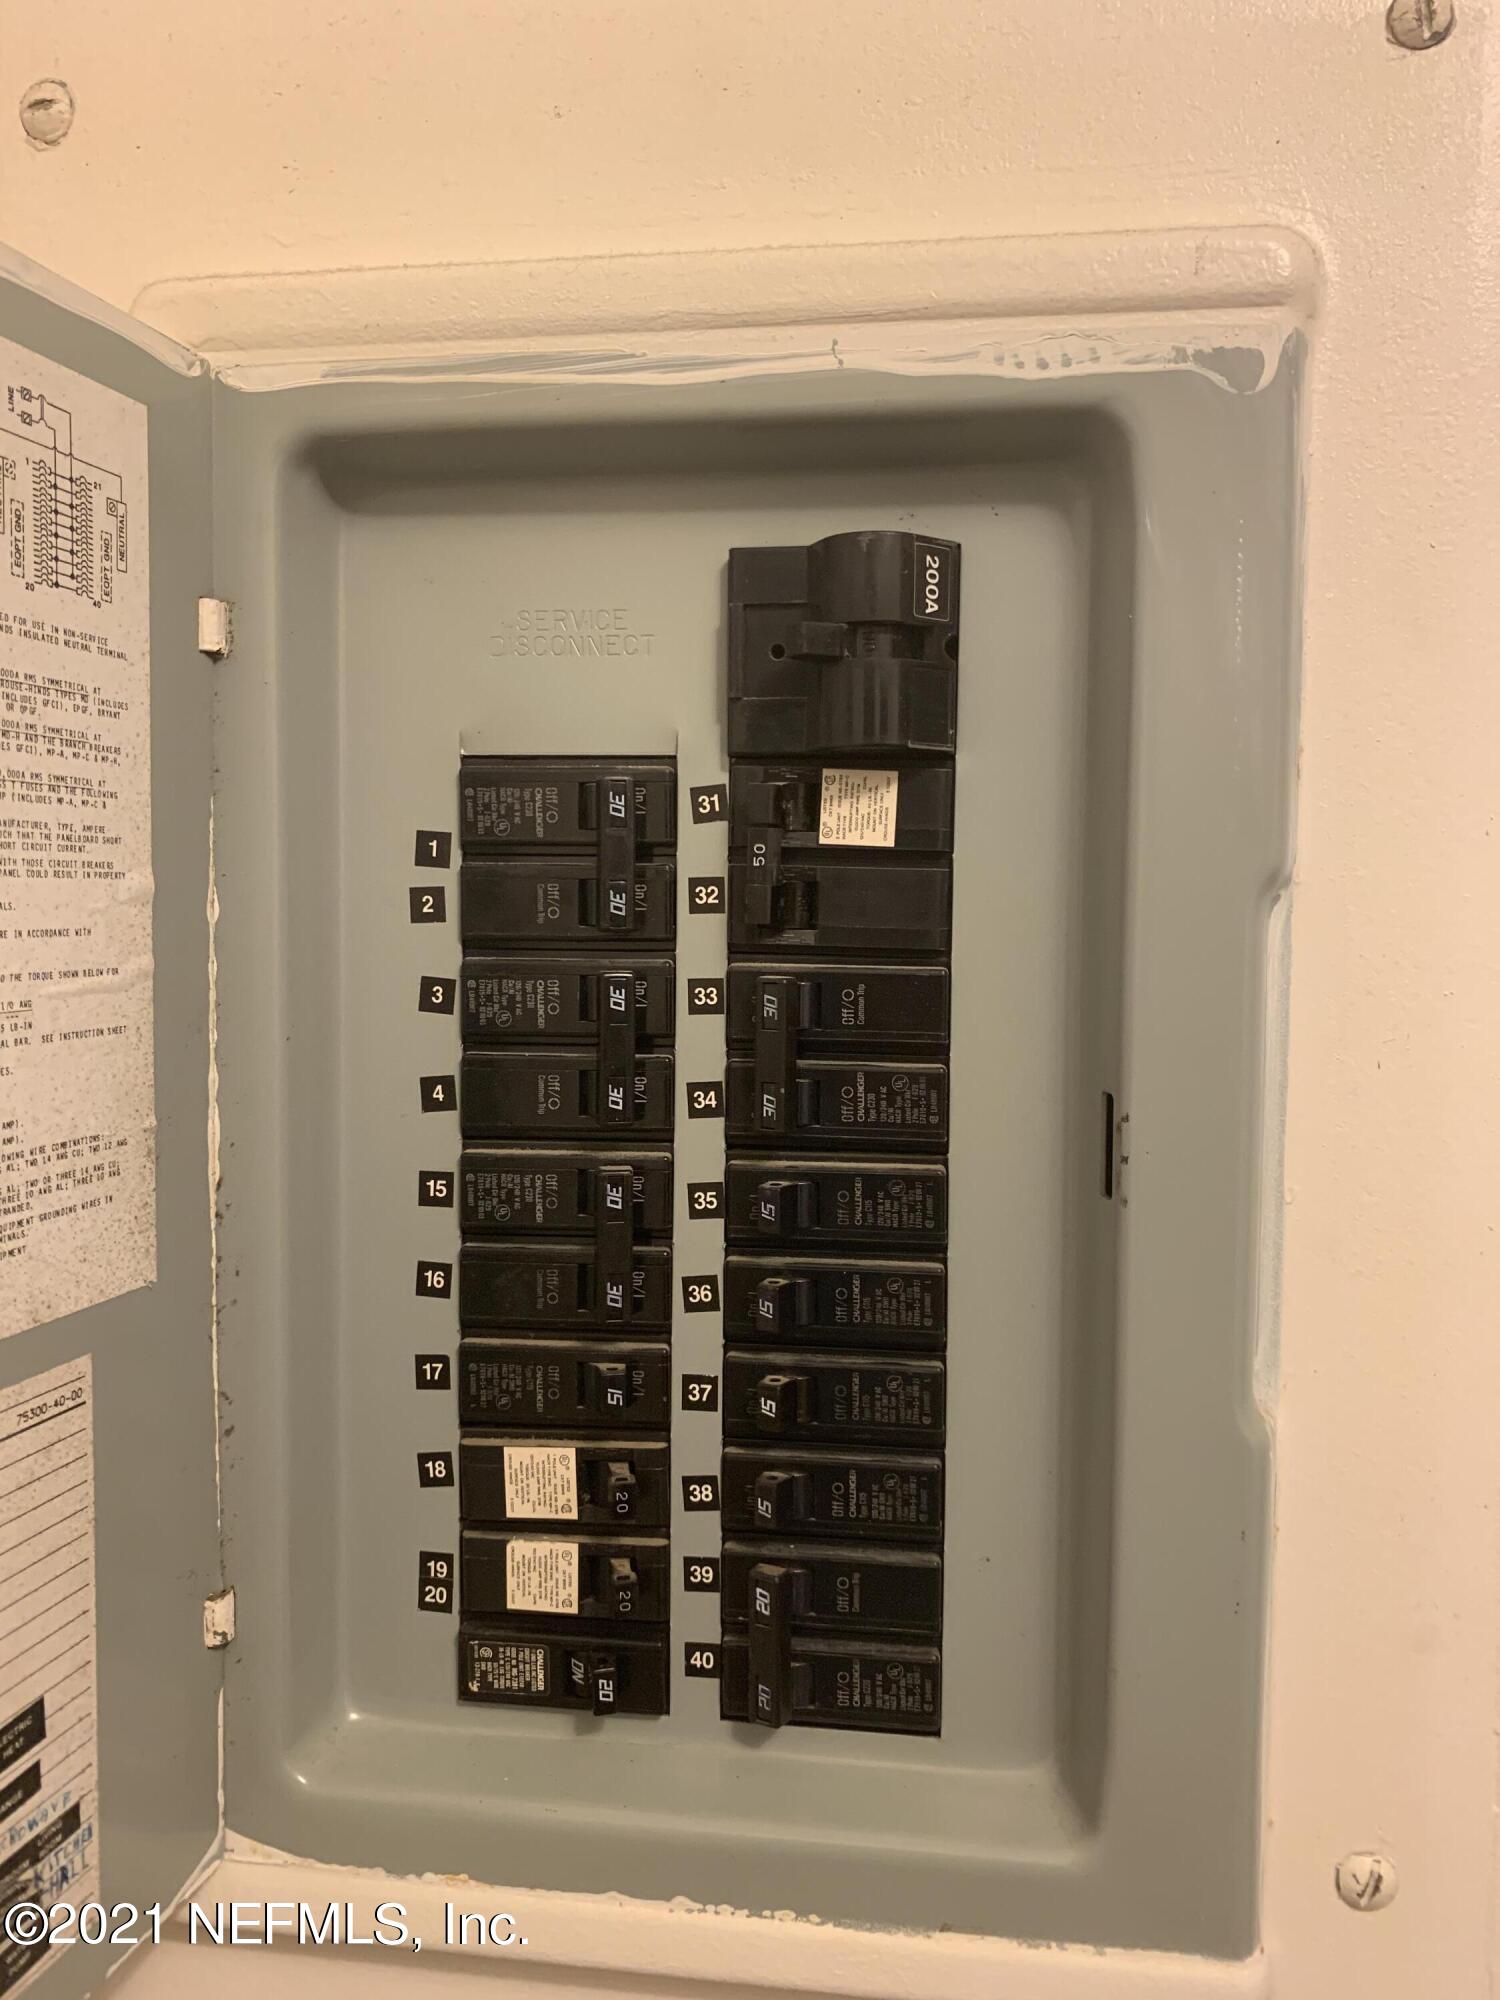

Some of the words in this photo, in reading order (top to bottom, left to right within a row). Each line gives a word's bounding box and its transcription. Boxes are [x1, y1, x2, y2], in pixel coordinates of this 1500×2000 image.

[14, 508, 22, 534] GND
[118, 512, 126, 563] NEUTRAL
[103, 537, 111, 563] GND
[25, 582, 35, 592] 20
[925, 554, 940, 614] 200A
[515, 609, 629, 631] SERVICE
[19, 628, 59, 646] INSULATED
[609, 791, 626, 818] 30
[698, 794, 721, 813] 31
[428, 839, 438, 858] 1
[753, 843, 766, 867] 50
[421, 895, 434, 913] 2
[609, 889, 627, 917] 30
[695, 886, 719, 905] 32
[431, 985, 443, 1004] 3
[609, 985, 626, 1012] 30
[693, 987, 718, 1006] 33
[432, 1084, 444, 1102] 4
[608, 1084, 624, 1111] 30
[693, 1090, 718, 1109] 34
[425, 1179, 447, 1198] 15
[606, 1183, 623, 1210] 30
[693, 1191, 718, 1211] 35
[761, 1200, 776, 1221] 15
[423, 1270, 445, 1289] 16
[606, 1281, 623, 1309] 30
[687, 1284, 713, 1304] 36
[759, 1298, 774, 1319] 15
[422, 1362, 443, 1381] 17
[607, 1387, 623, 1406] 15
[687, 1383, 712, 1401] 37
[760, 1396, 777, 1418] 15
[423, 1460, 446, 1479] 18
[615, 1491, 629, 1513] 20
[688, 1484, 713, 1503] 38
[757, 1496, 773, 1519] 15
[426, 1560, 447, 1578] 19
[689, 1565, 714, 1583] 39
[423, 1585, 447, 1603] 20
[619, 1590, 632, 1612] 20
[755, 1587, 771, 1616] 20
[536, 1648, 545, 1691] CHALLENGER
[690, 1651, 714, 1669] 40
[570, 1657, 585, 1685] ON
[598, 1678, 614, 1702] 20
